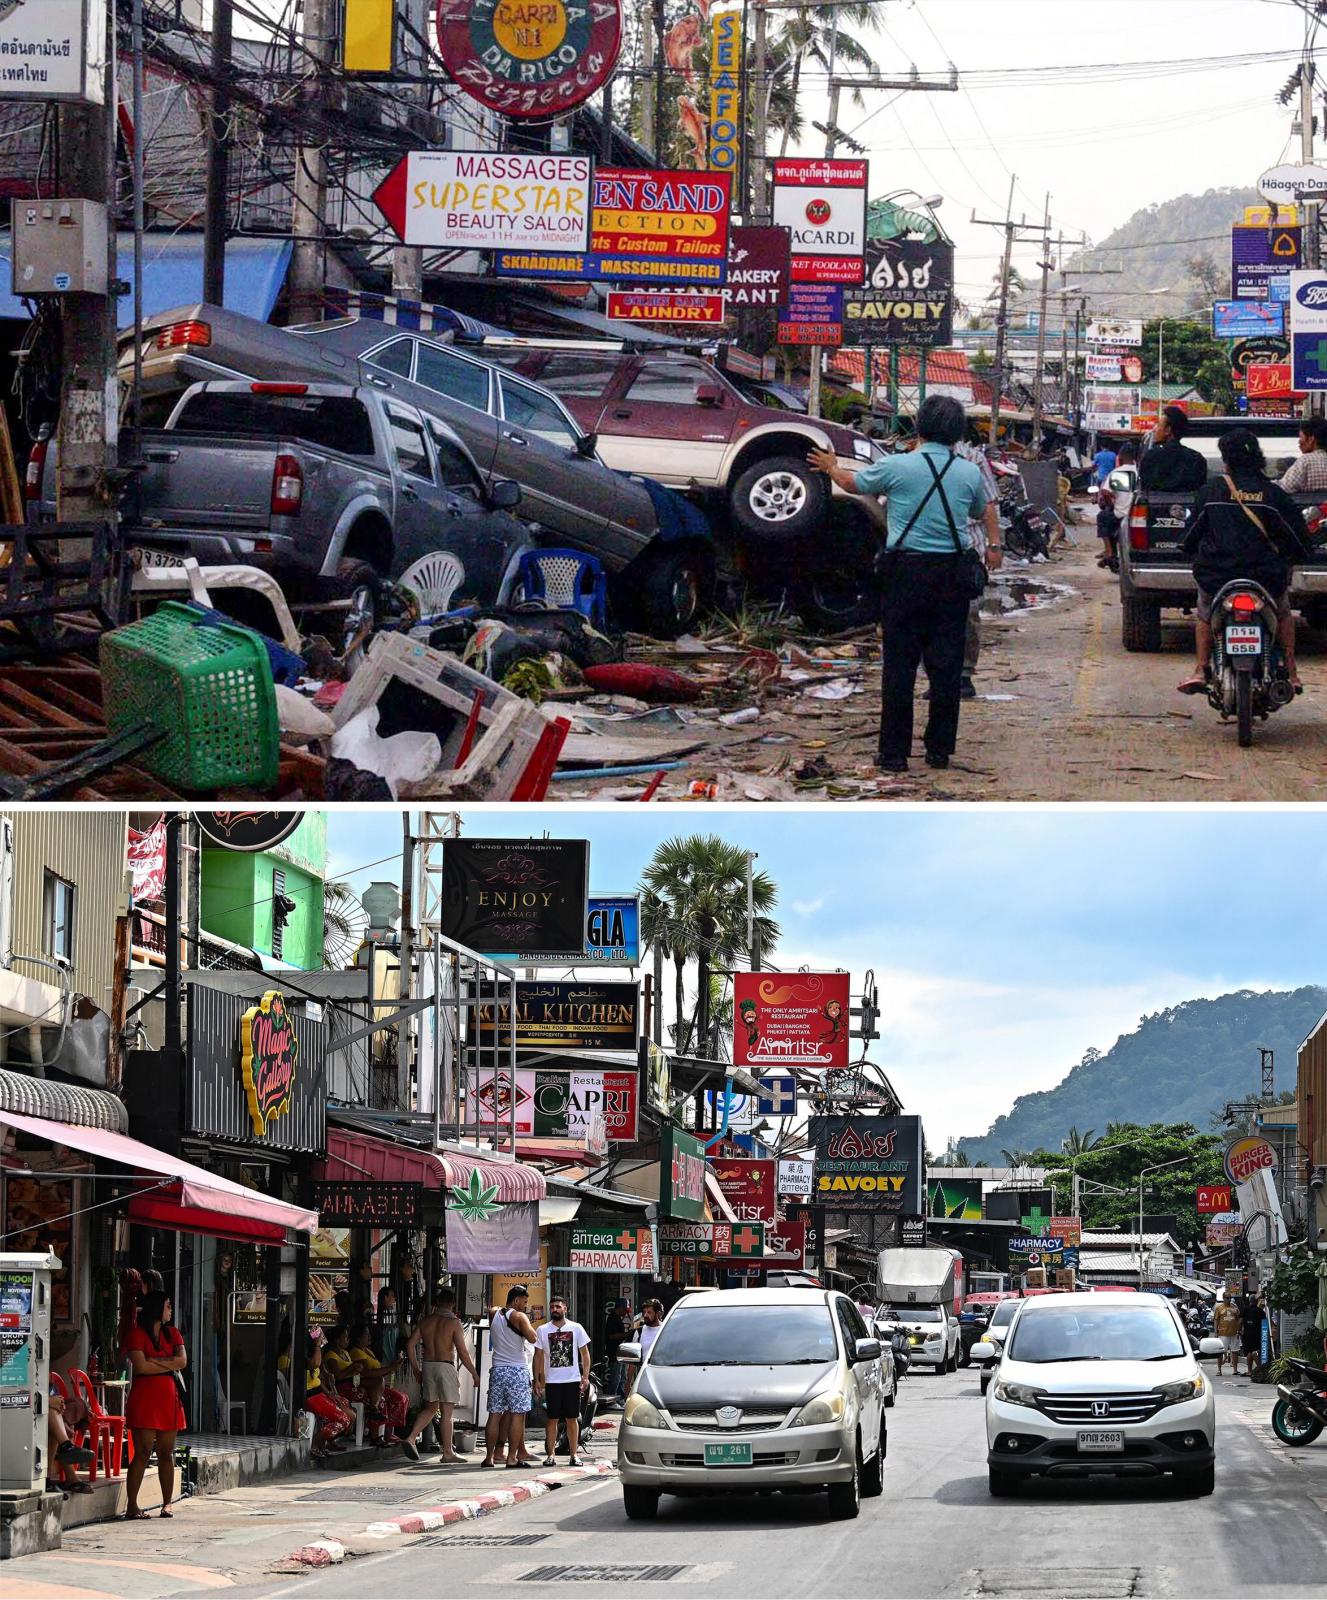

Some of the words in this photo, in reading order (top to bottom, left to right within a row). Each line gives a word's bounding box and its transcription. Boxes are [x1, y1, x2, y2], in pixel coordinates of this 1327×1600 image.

[456, 156, 588, 182] MASSAGES
[412, 181, 584, 215] SUPERSTAR
[641, 181, 725, 213] SAND
[447, 213, 518, 229] BEAUTY
[523, 215, 584, 232] SALON
[599, 214, 707, 231] ECTION
[541, 232, 581, 243] MIDNIGHT
[617, 236, 668, 253] Custom
[675, 239, 722, 255] Tailors
[600, 259, 721, 279] MASSCHNEIDEREI
[812, 261, 861, 271] FOODLAND
[1237, 278, 1254, 286] ATM
[614, 304, 715, 320] LAUNDRY
[846, 302, 945, 319] SAVOEY
[1232, 645, 1256, 653] 658
[479, 891, 553, 911] ENJOY
[587, 909, 626, 948] GLA
[611, 948, 628, 961] LTD.
[543, 1002, 634, 1024] KITCHEN
[253, 1016, 291, 1066] Magic
[756, 1036, 823, 1055] Amritsr
[257, 1056, 293, 1111] Gallery
[536, 1075, 570, 1084] Italian
[574, 1077, 630, 1087] Restaurant
[533, 1084, 631, 1116] CAPRI
[1230, 1144, 1270, 1168] BURGER
[818, 1161, 909, 1172] RESTAURANT
[1233, 1153, 1273, 1180] KING
[779, 1174, 811, 1184] PHARMACY
[818, 1176, 906, 1192] SAVOEY
[781, 1184, 809, 1192] аптека
[572, 1233, 613, 1246] аптека
[660, 1226, 710, 1239] ARMACY
[1008, 1239, 1062, 1249] PHARMACY
[571, 1252, 635, 1269] PHARMACY
[10, 1275, 33, 1283] MOON
[1099, 1433, 1121, 1442] 2603
[730, 1445, 746, 1455] 261
